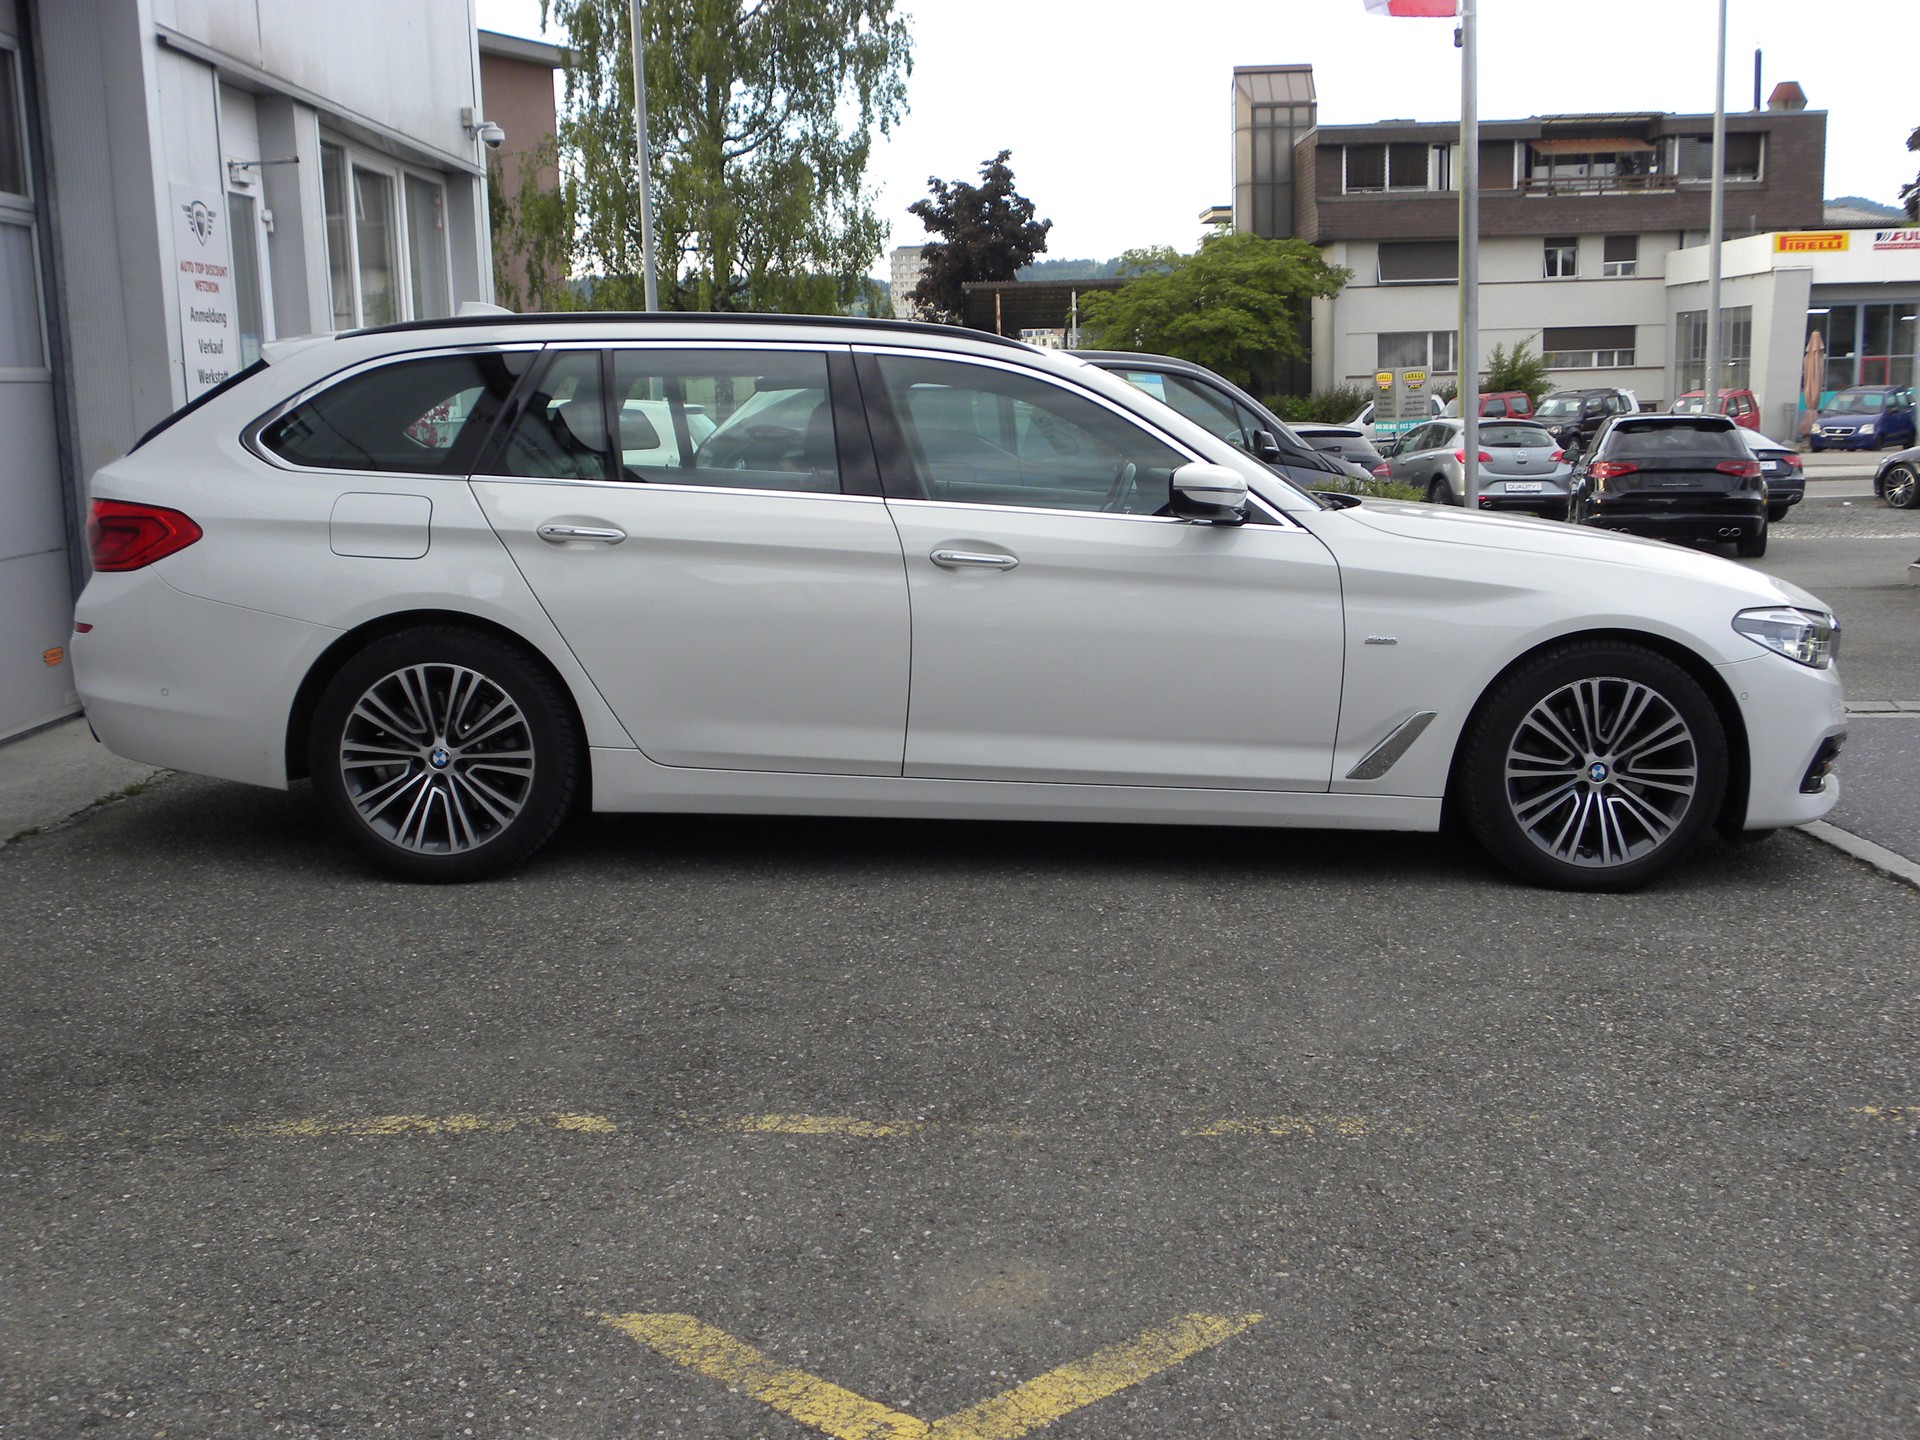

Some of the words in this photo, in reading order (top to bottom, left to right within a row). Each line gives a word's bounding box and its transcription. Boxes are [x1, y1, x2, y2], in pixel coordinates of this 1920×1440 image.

[1780, 235, 1843, 250] PIRELLI
[180, 260, 194, 273] AUTO
[194, 261, 204, 275] TOP
[204, 263, 228, 277] DISCOUNT
[190, 306, 227, 328] Anmeldung
[198, 338, 224, 354] Verkauf
[198, 368, 229, 384] Werkstatt
[1403, 371, 1425, 380] GARAGE
